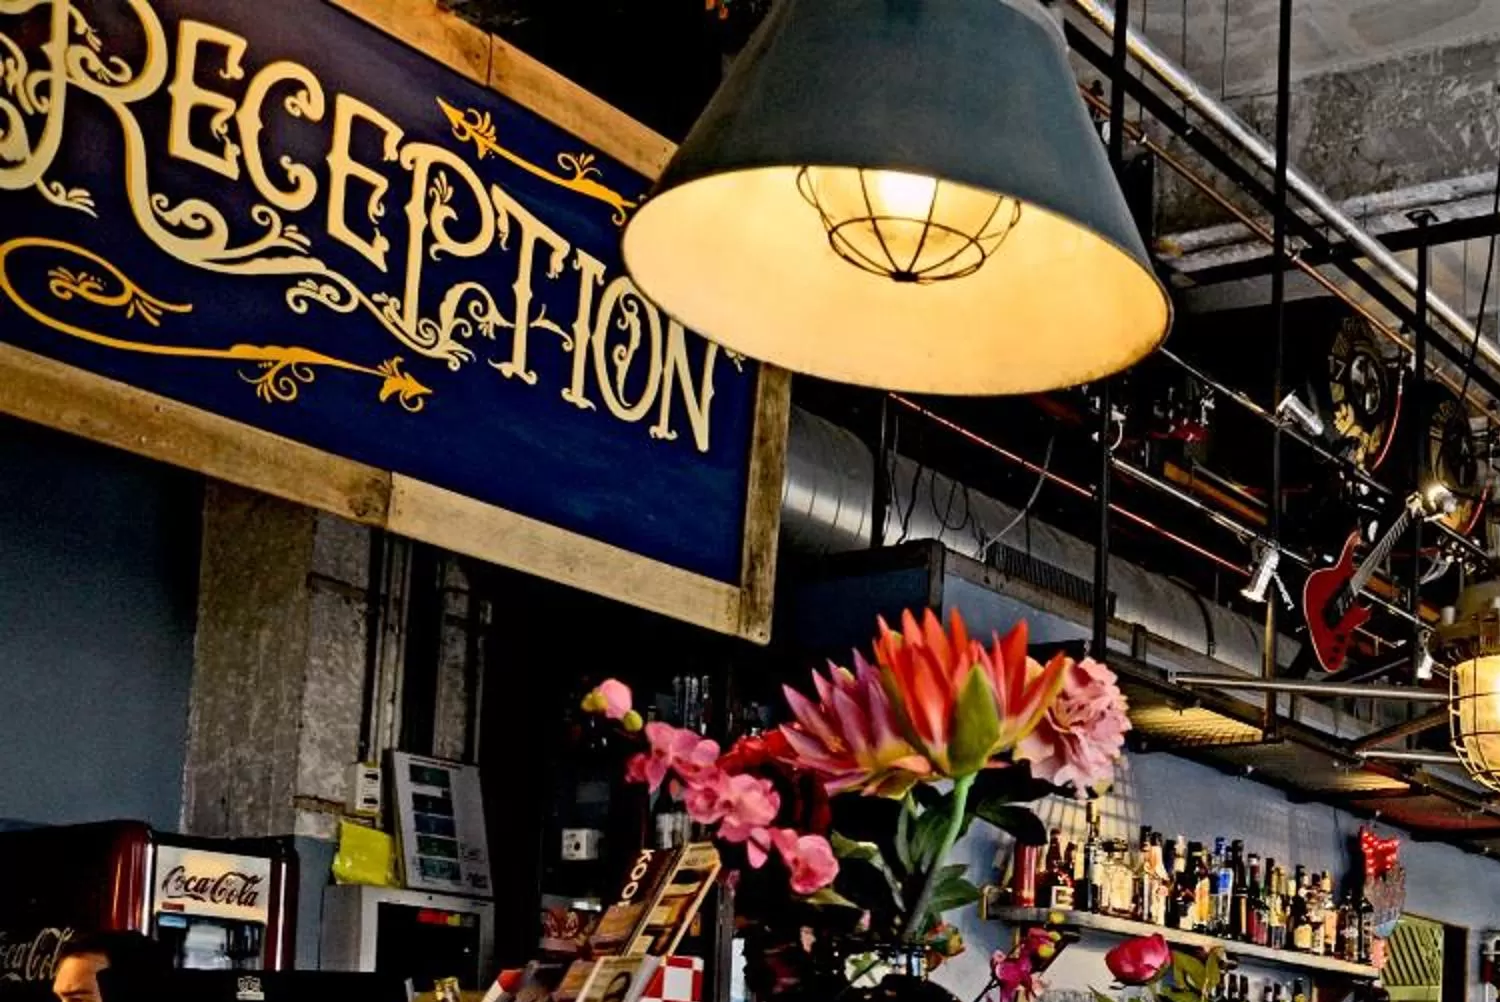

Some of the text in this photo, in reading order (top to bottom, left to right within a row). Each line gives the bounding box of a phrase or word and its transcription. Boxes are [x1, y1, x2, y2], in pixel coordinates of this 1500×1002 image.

[0, 0, 718, 451] RECEPTION
[161, 865, 265, 907] Coca-Cola
[617, 849, 656, 906] KOO
